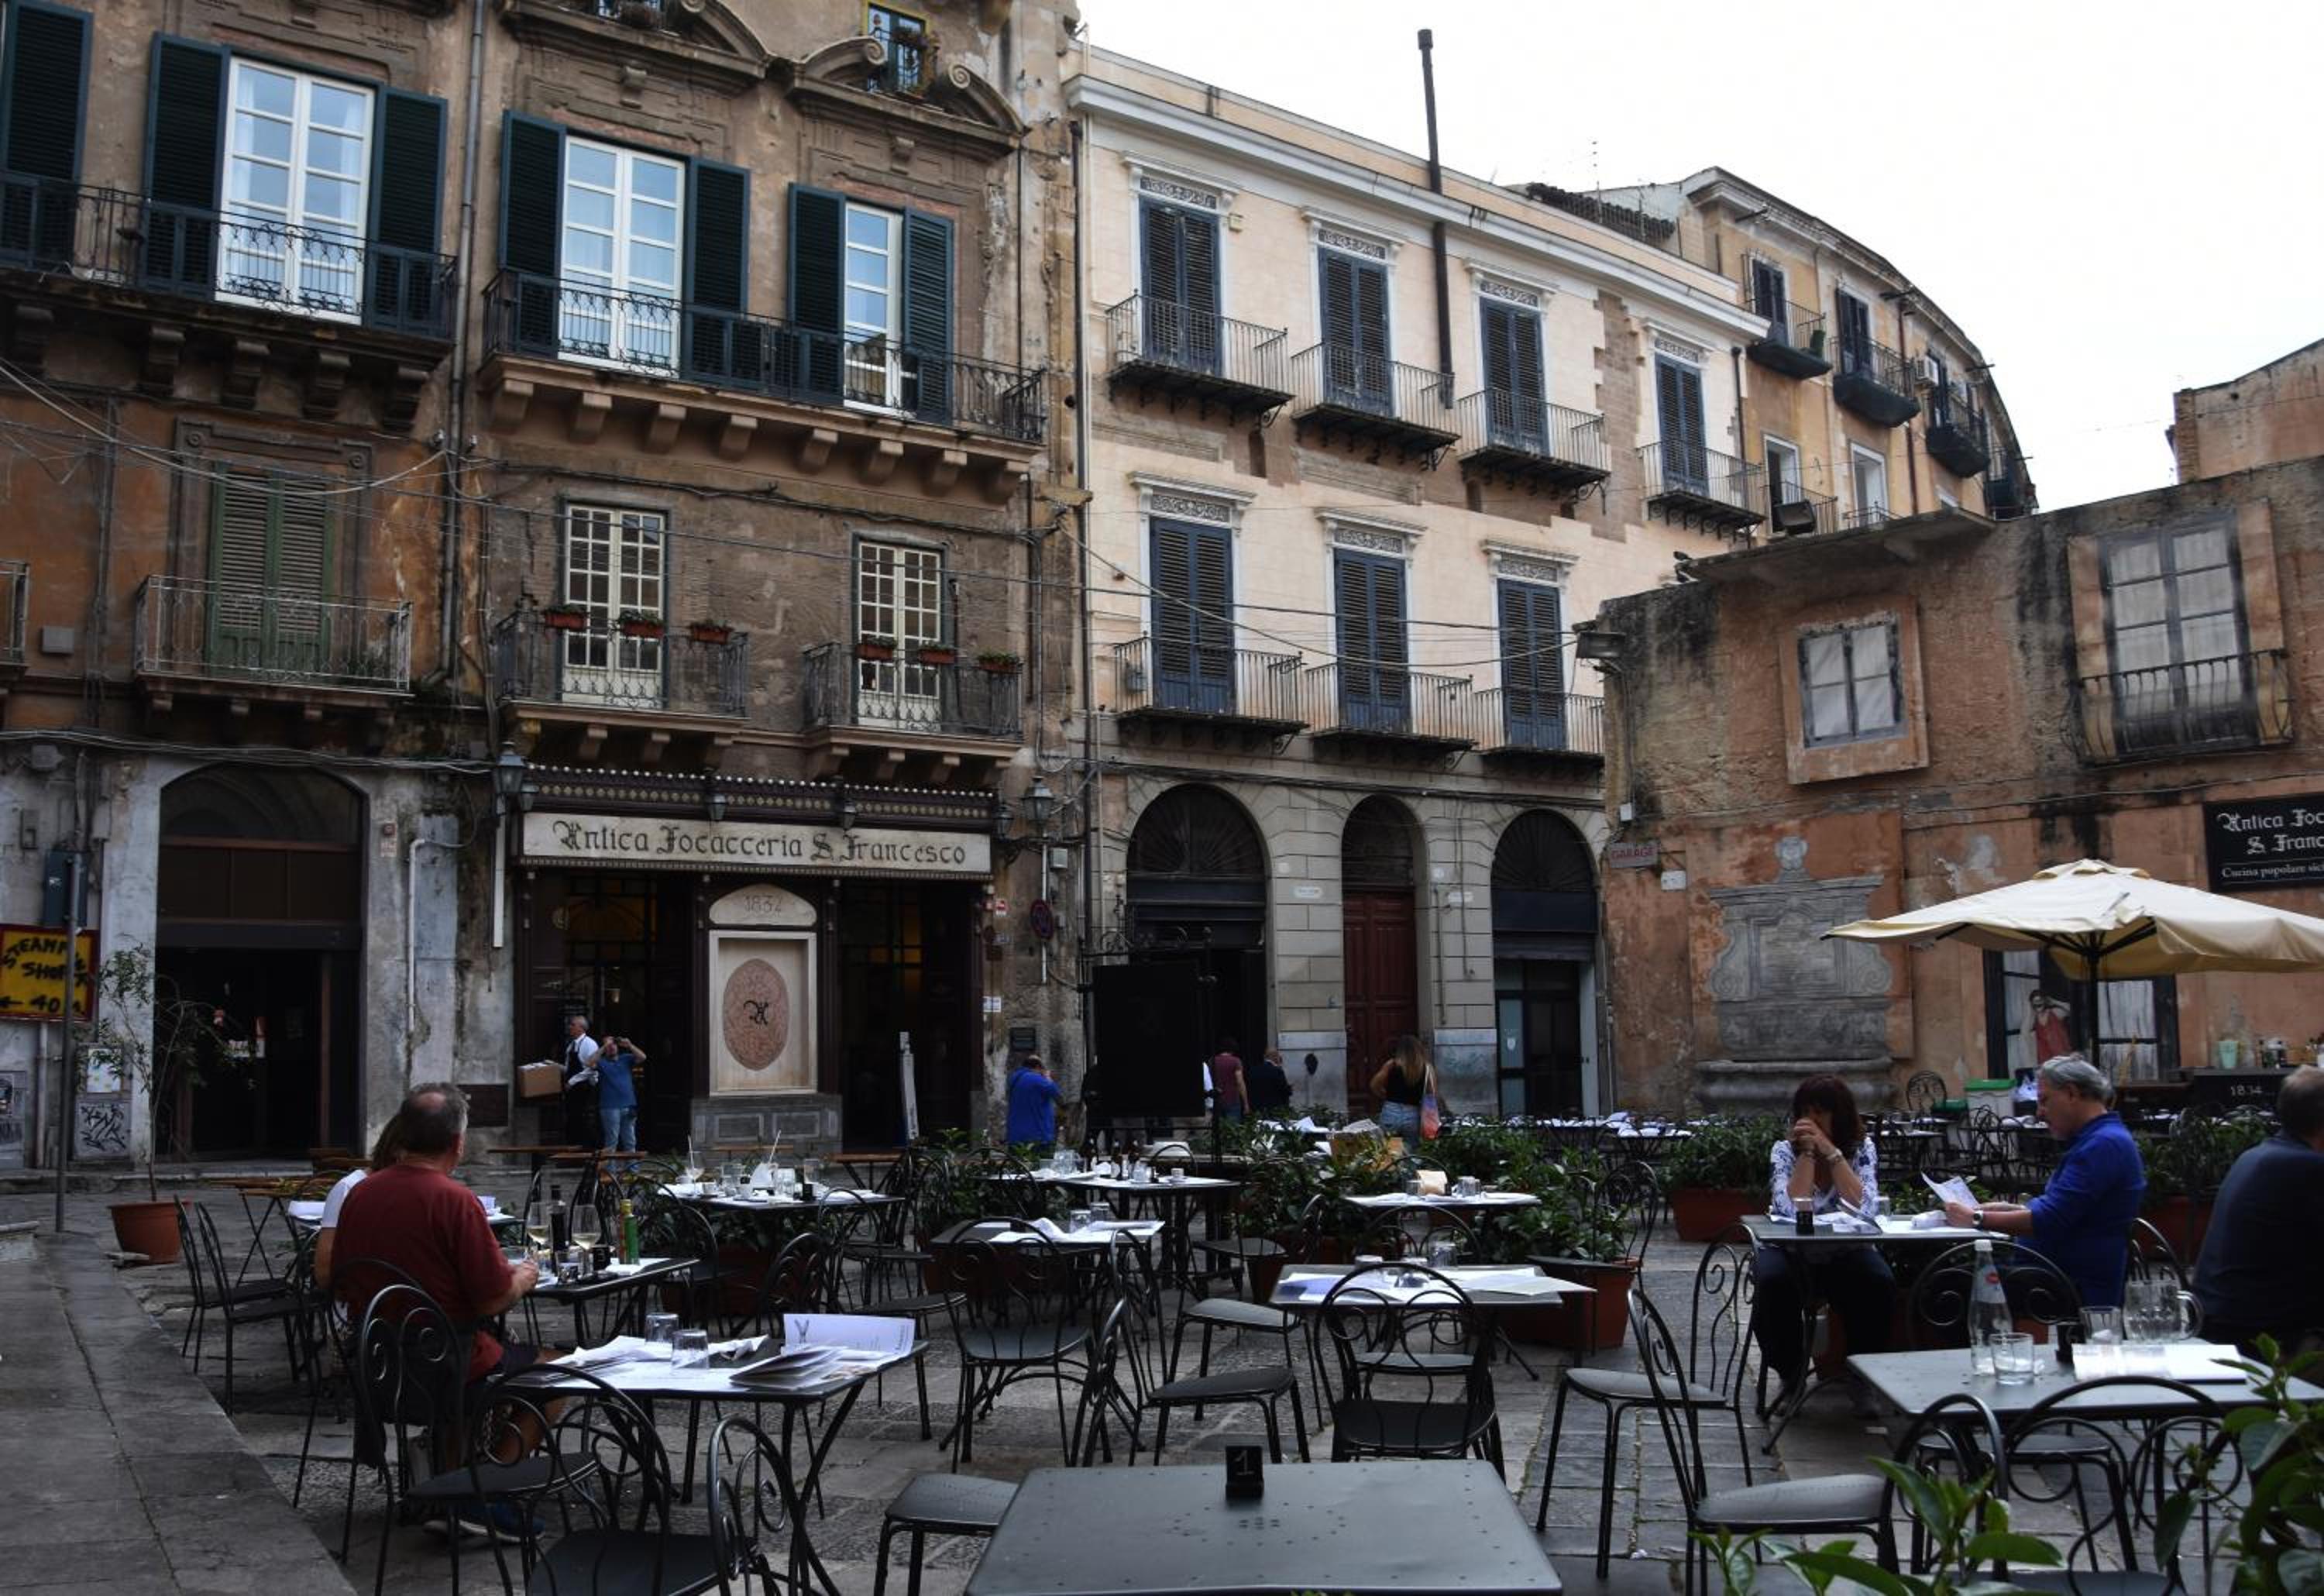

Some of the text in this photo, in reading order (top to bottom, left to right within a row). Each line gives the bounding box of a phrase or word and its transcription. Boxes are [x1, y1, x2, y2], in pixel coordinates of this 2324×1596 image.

[2217, 813, 2284, 832] Antica
[552, 820, 649, 851] Antica
[656, 825, 803, 857] Focacceria
[839, 834, 965, 865] Francesco
[2221, 867, 2258, 878] Cucina
[2260, 864, 2306, 879] popolare
[1235, 1450, 1253, 1476] 1
